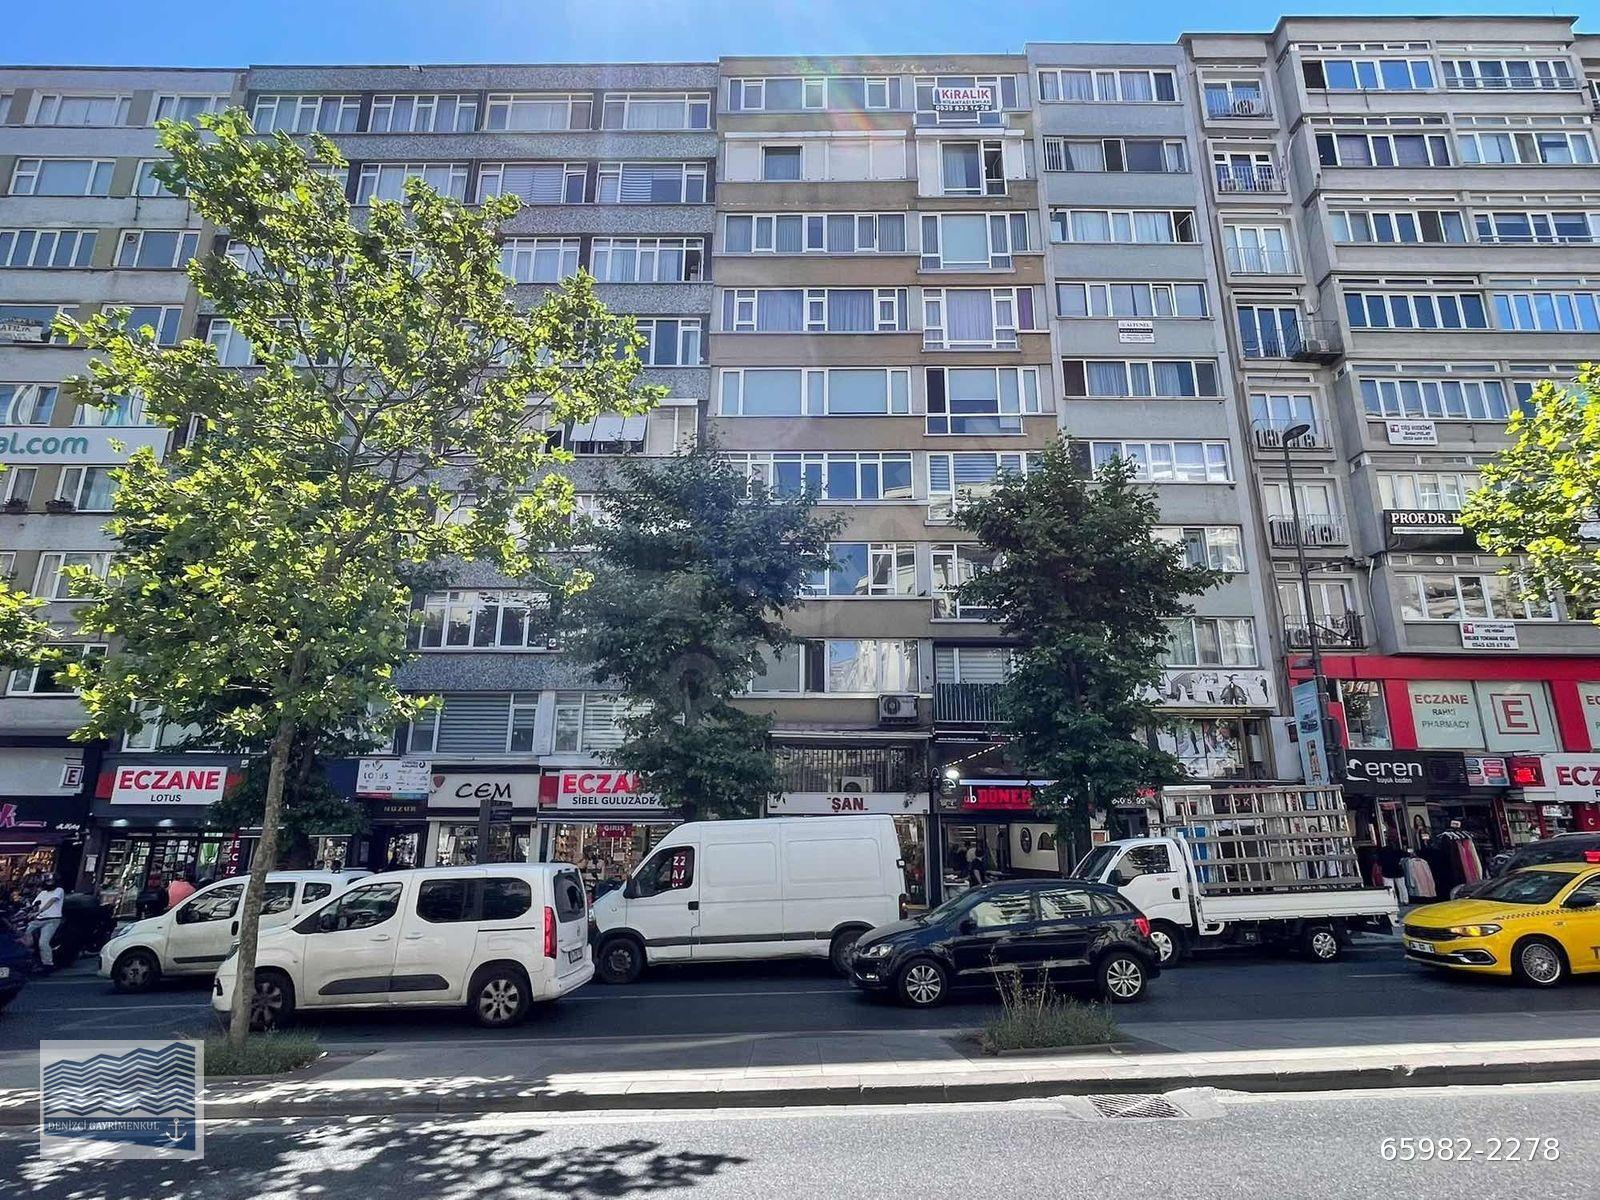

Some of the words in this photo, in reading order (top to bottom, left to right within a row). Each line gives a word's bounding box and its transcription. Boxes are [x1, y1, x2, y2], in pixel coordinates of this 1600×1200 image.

[1414, 694, 1469, 705] ECZANE
[1501, 700, 1529, 728] E
[118, 770, 222, 790] ECZANE
[150, 794, 182, 802] LOTUS
[454, 782, 512, 800] CEM
[572, 794, 599, 805] SİBEL
